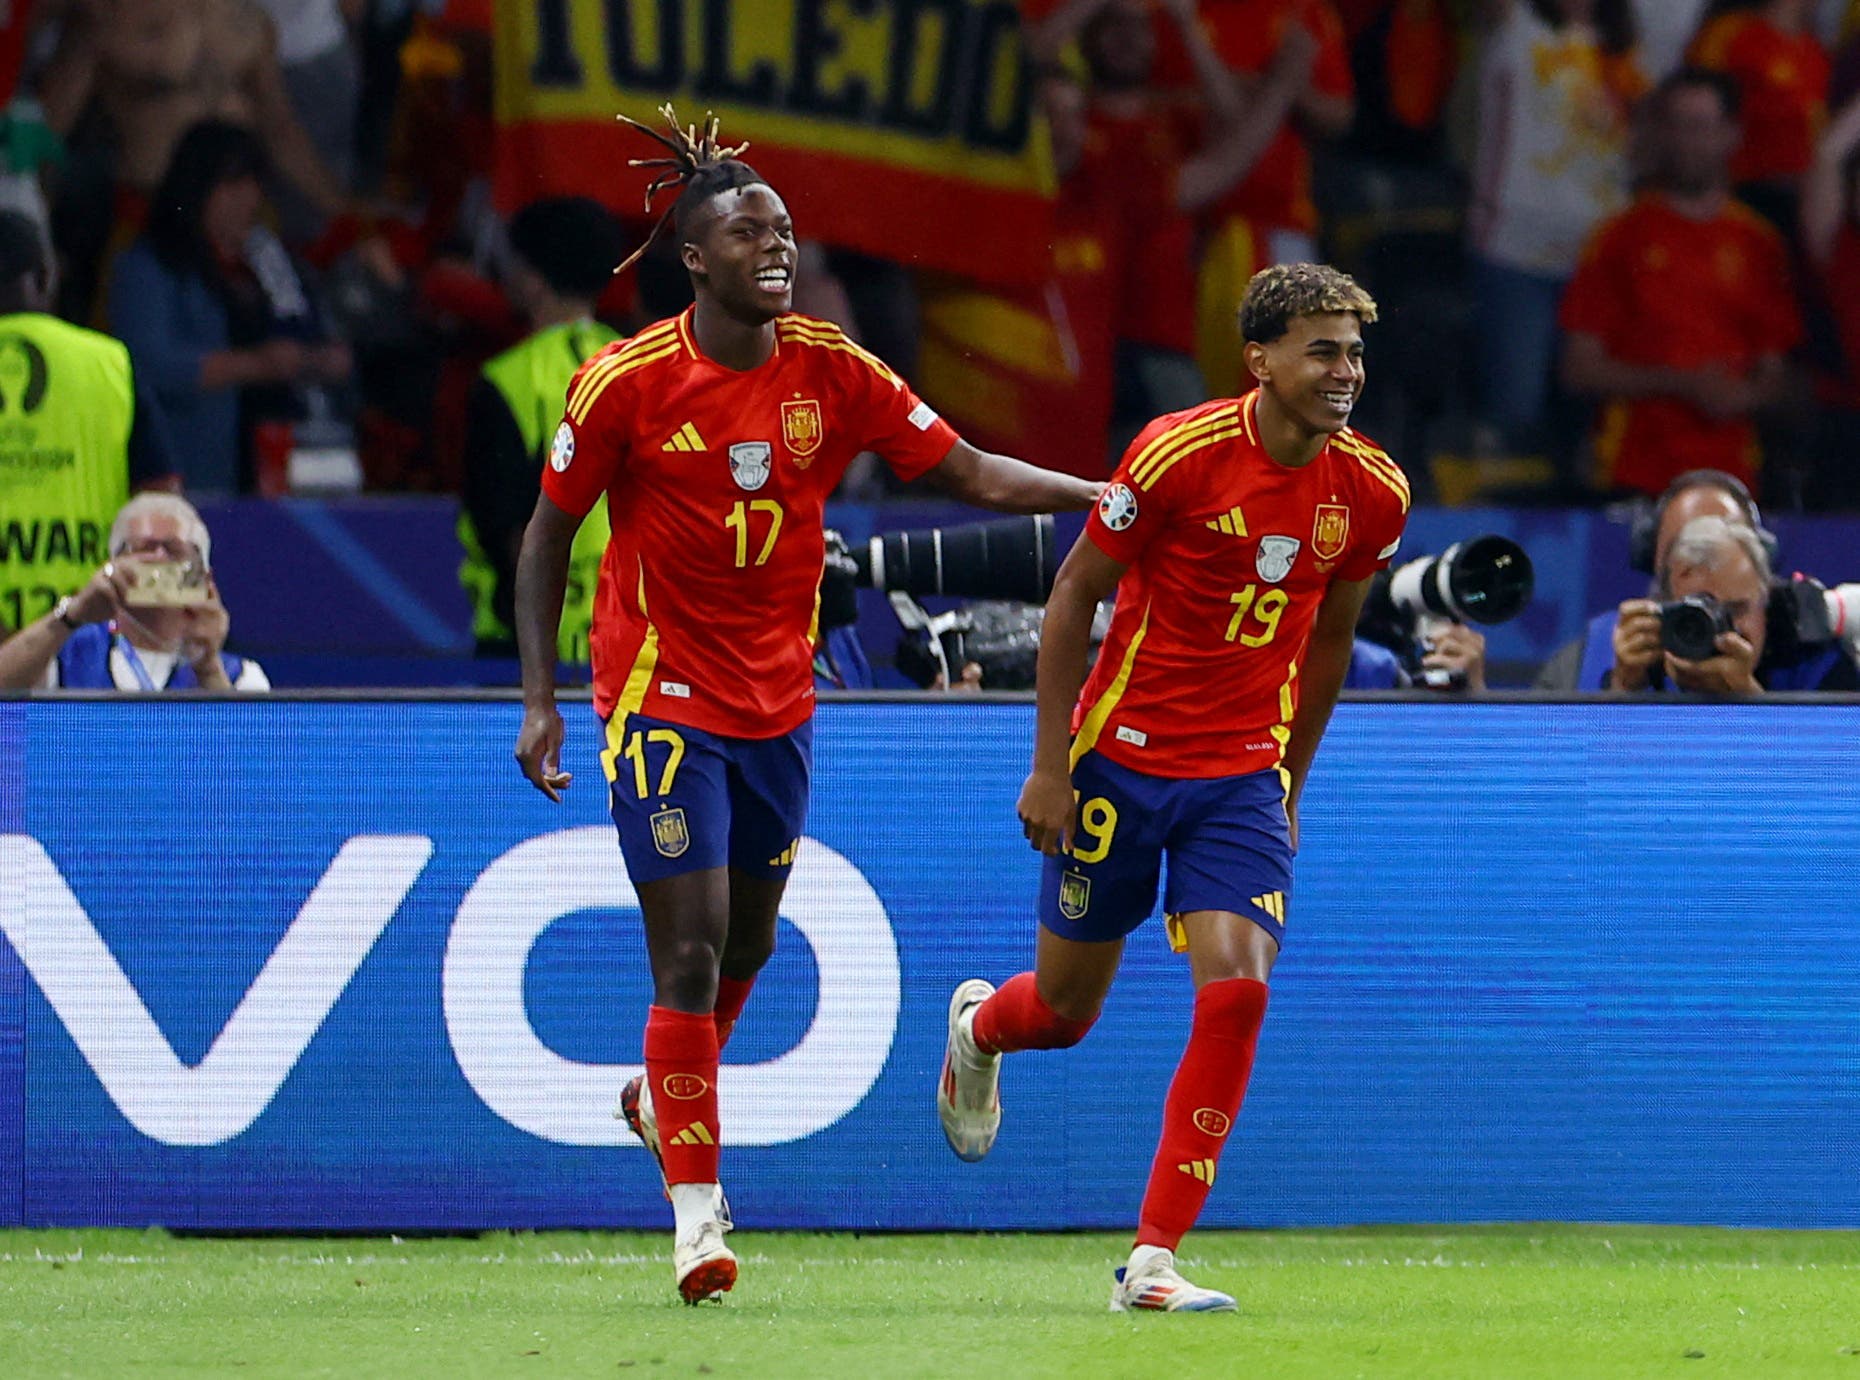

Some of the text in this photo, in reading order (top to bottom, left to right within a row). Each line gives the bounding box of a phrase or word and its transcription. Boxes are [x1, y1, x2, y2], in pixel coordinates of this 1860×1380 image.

[725, 499, 783, 567] 17
[1224, 584, 1289, 648] 19
[625, 728, 684, 799] 17
[1061, 789, 1118, 864] 9
